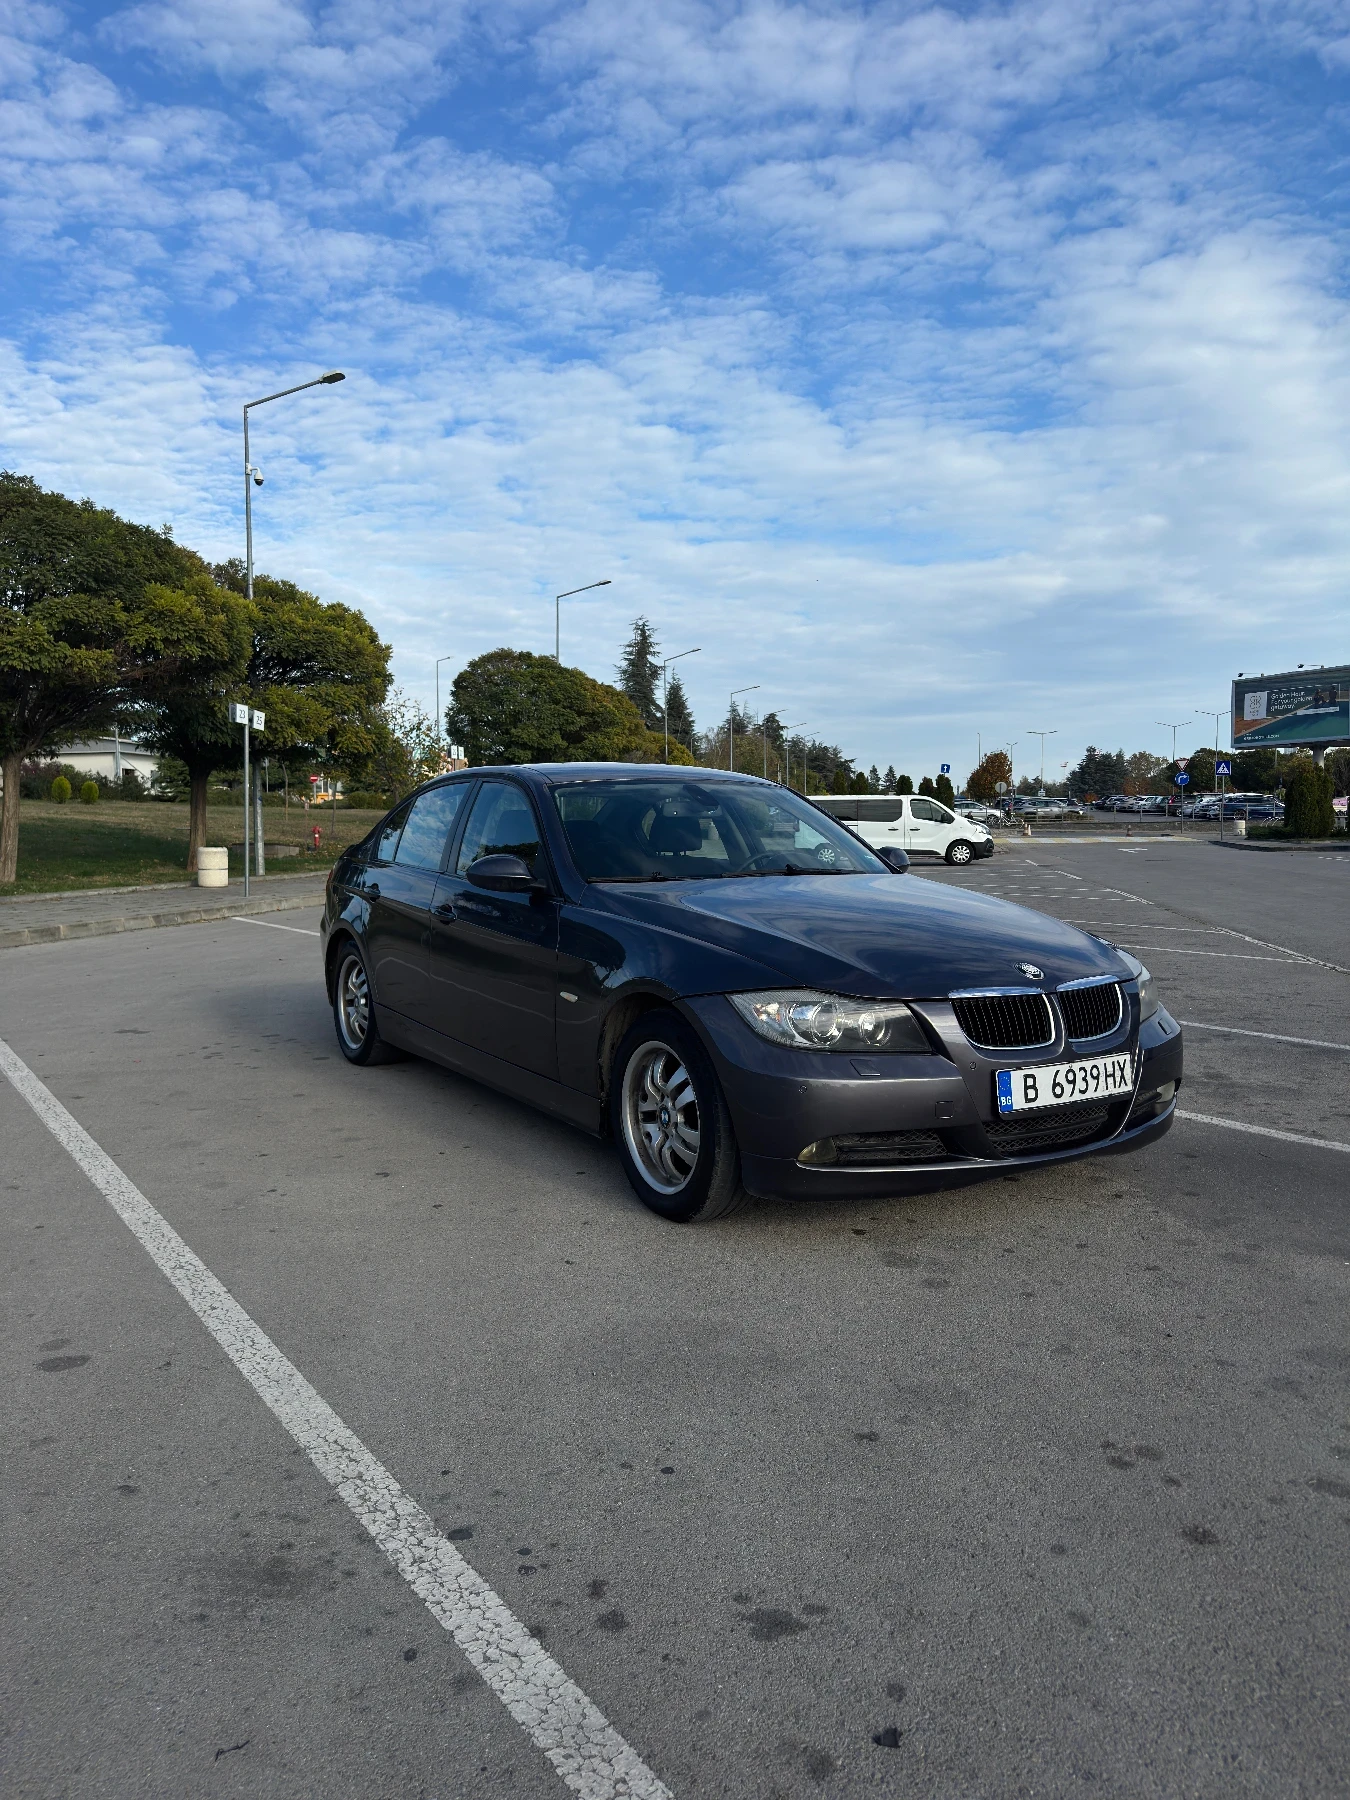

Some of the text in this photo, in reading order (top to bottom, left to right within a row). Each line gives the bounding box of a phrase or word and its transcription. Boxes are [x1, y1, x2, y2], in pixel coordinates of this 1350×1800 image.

[239, 709, 246, 719] 23
[1023, 1073, 1039, 1104] B
[1000, 1096, 1012, 1106] BG
